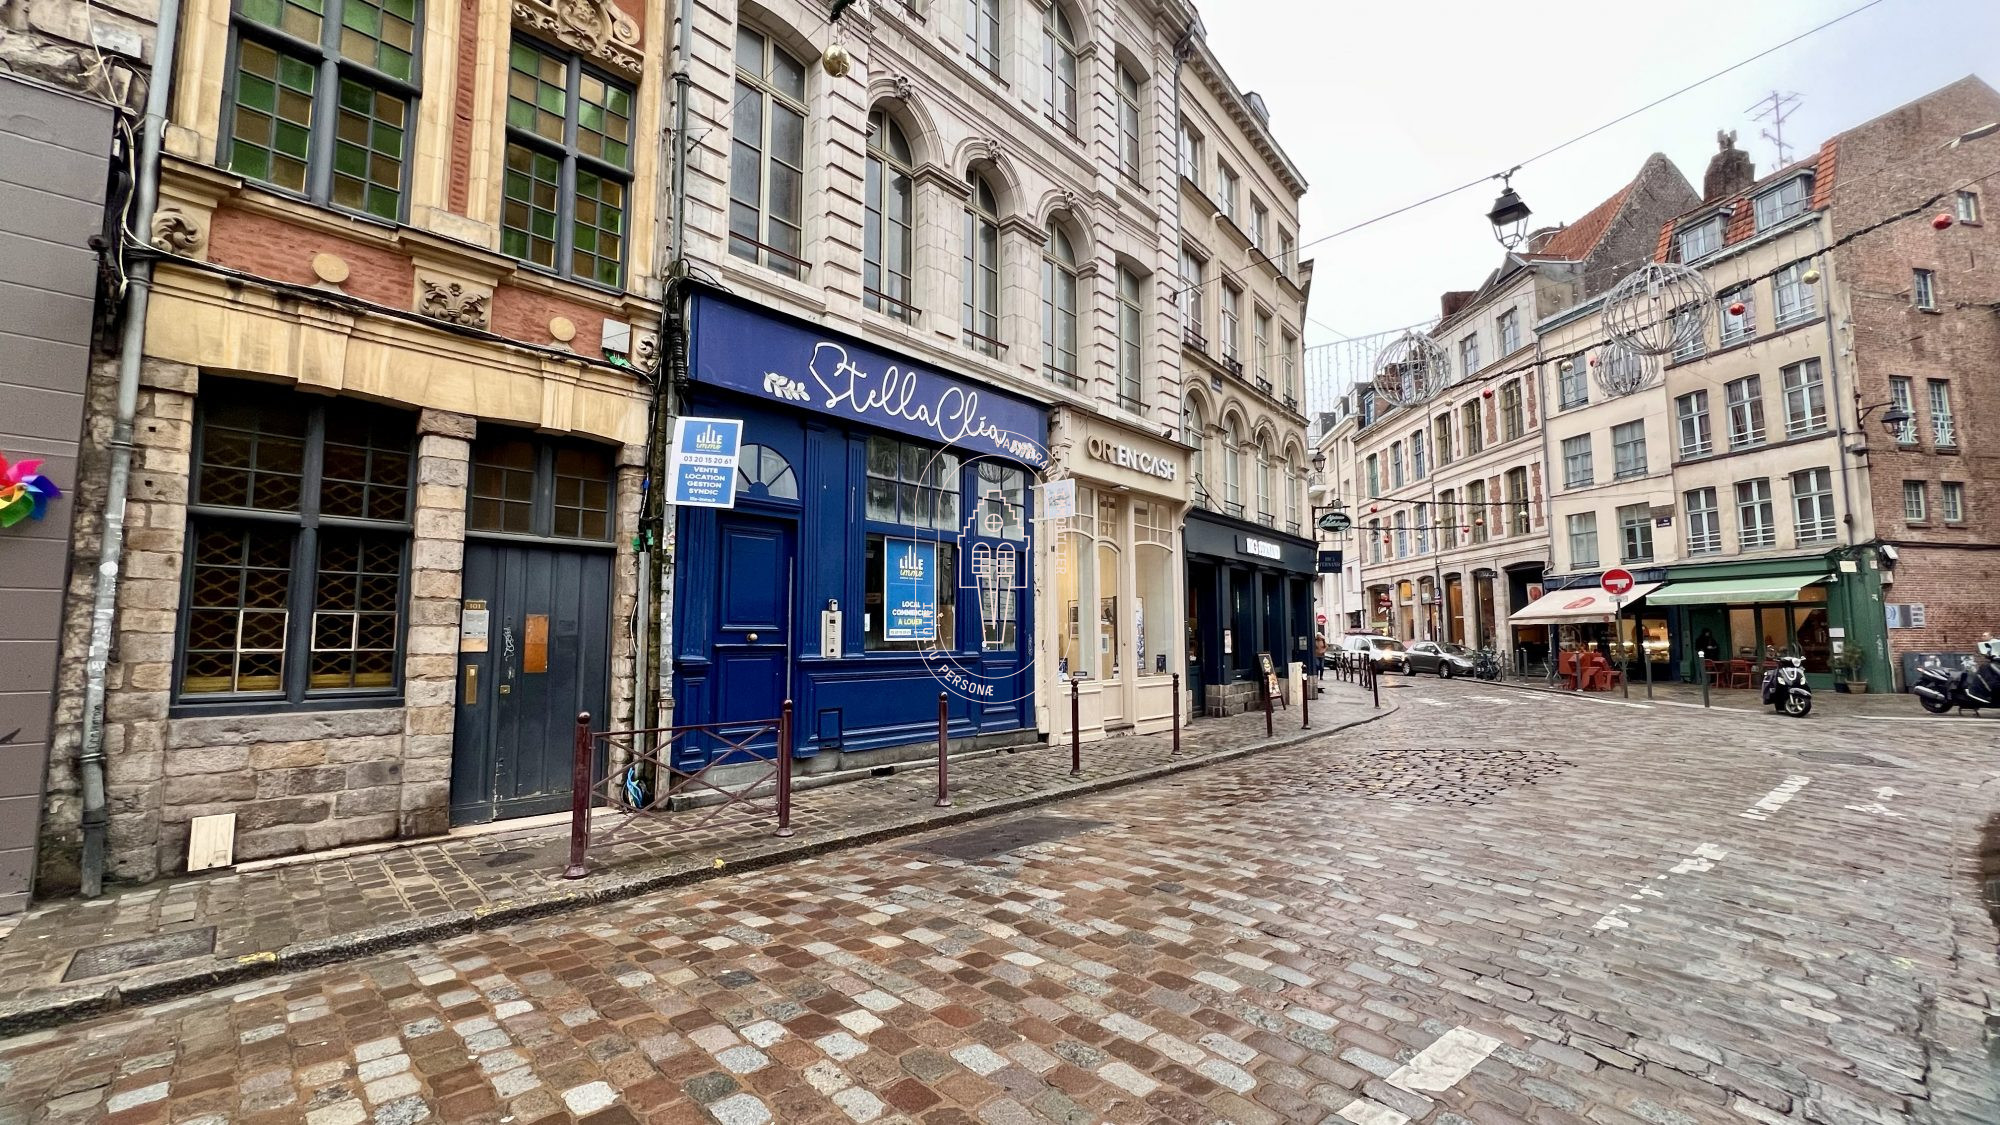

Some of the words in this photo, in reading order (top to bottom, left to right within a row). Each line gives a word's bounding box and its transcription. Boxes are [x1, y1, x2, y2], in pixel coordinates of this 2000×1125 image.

[1088, 436, 1116, 464] OR
[1117, 445, 1139, 471] EN
[1140, 453, 1177, 480] CASH
[694, 466, 718, 474] VENTE
[685, 473, 725, 481] LOCATION
